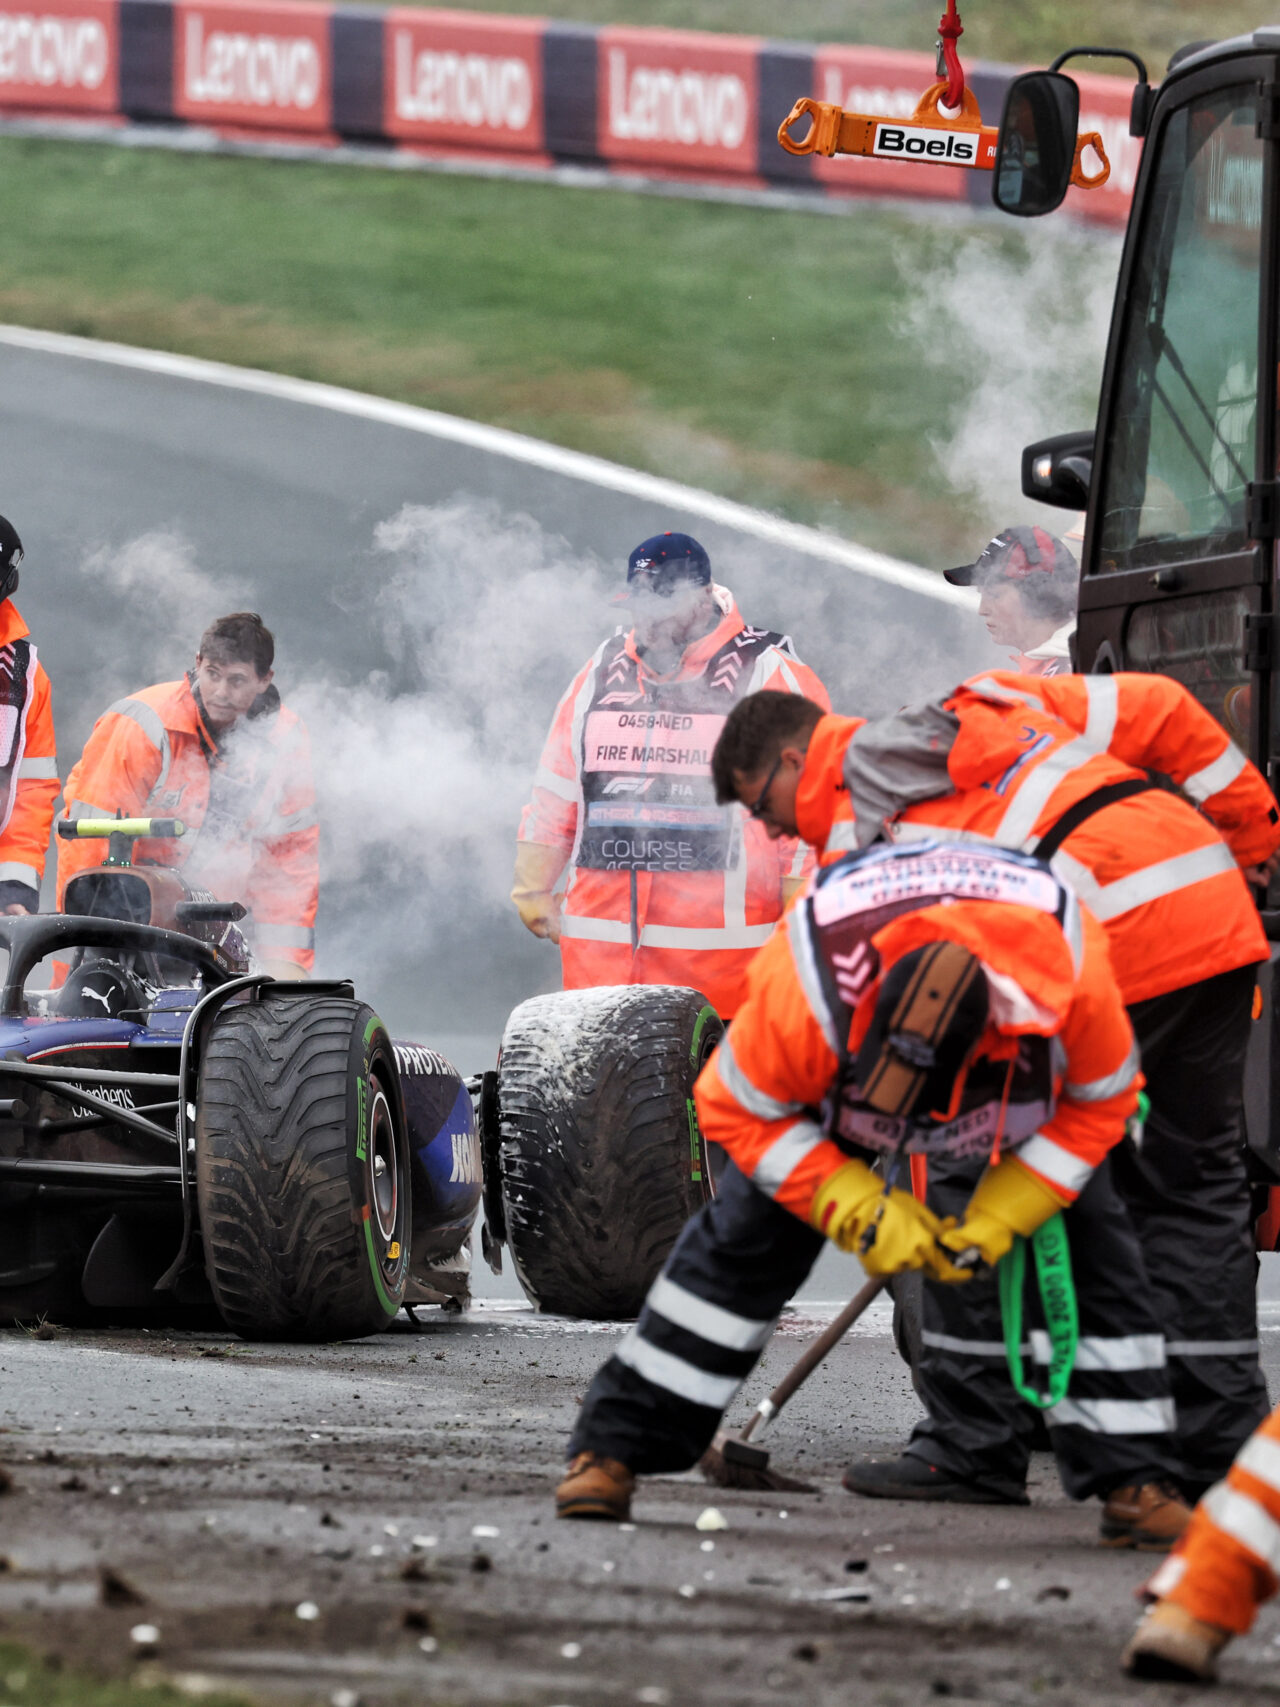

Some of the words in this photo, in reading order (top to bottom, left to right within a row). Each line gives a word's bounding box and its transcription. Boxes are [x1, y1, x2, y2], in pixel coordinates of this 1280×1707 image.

[185, 13, 319, 108] Lenovo
[395, 29, 532, 130] Lenovo
[609, 50, 747, 148] Lenovo
[878, 128, 974, 159] Boels
[597, 745, 628, 761] FIRE
[631, 747, 711, 766] MARSHAL
[602, 840, 693, 859] COURSE
